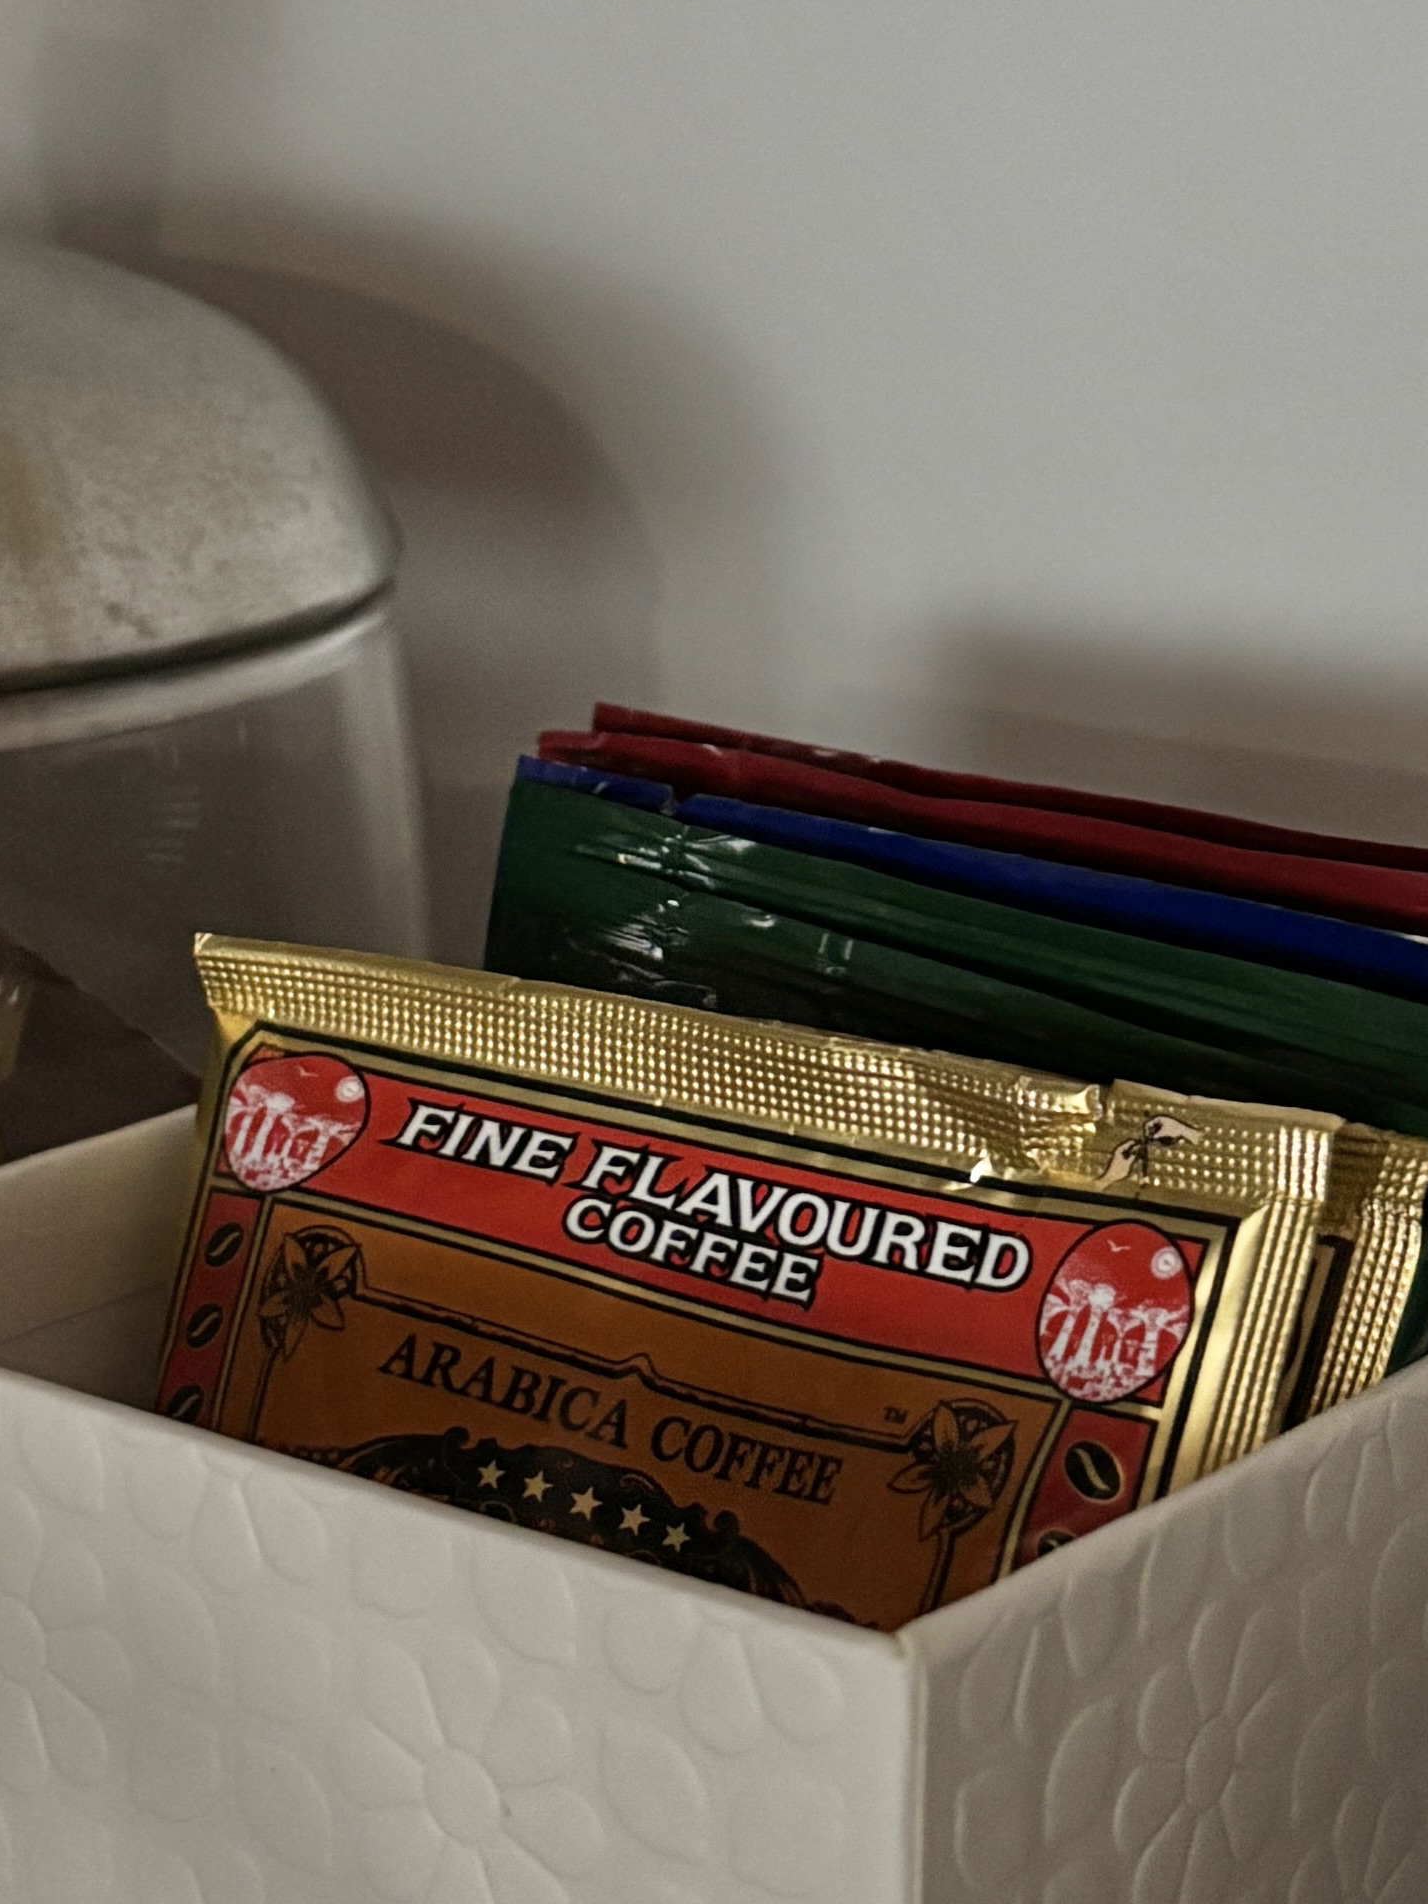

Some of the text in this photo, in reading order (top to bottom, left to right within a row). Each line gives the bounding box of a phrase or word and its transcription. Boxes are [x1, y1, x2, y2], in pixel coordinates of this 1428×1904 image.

[387, 1100, 1031, 1292] FINE FLAVOURED
[562, 1197, 819, 1306] COFFEE
[377, 1332, 844, 1506] ARABICA COFFEE
